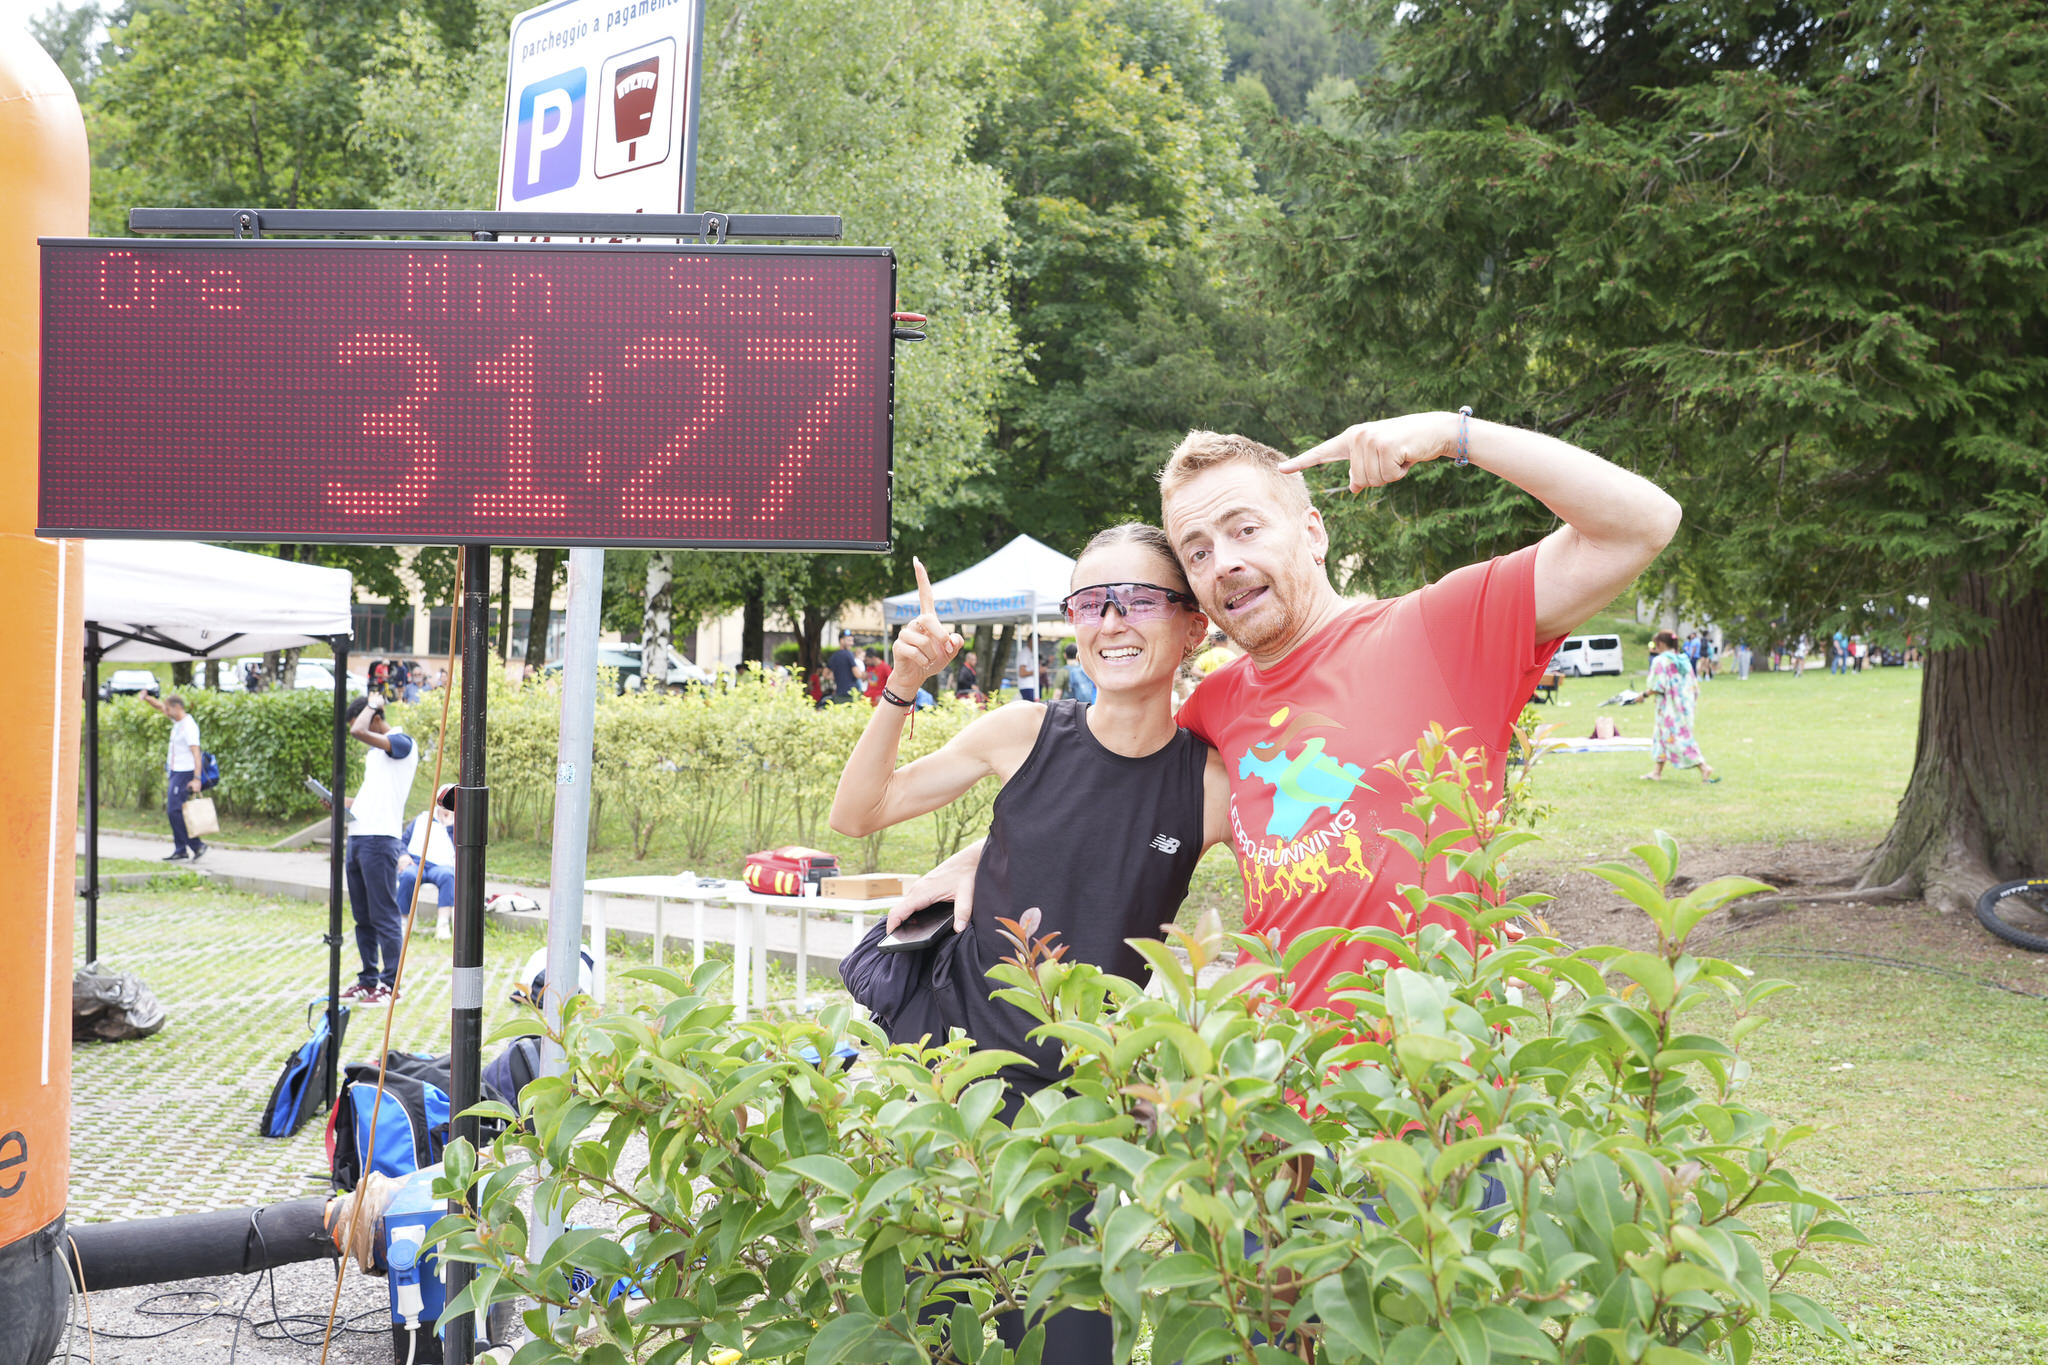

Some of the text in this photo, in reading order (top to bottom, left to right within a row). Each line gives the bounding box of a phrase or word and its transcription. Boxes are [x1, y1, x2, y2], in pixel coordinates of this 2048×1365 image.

[522, 0, 679, 63] parcheggio a pagamen
[527, 88, 573, 185] P
[101, 252, 814, 316] Ore Min Sec
[327, 332, 857, 520] 31:27
[896, 595, 1026, 617] ATLCA VIGHENZI
[1256, 809, 1357, 867] RUNNING
